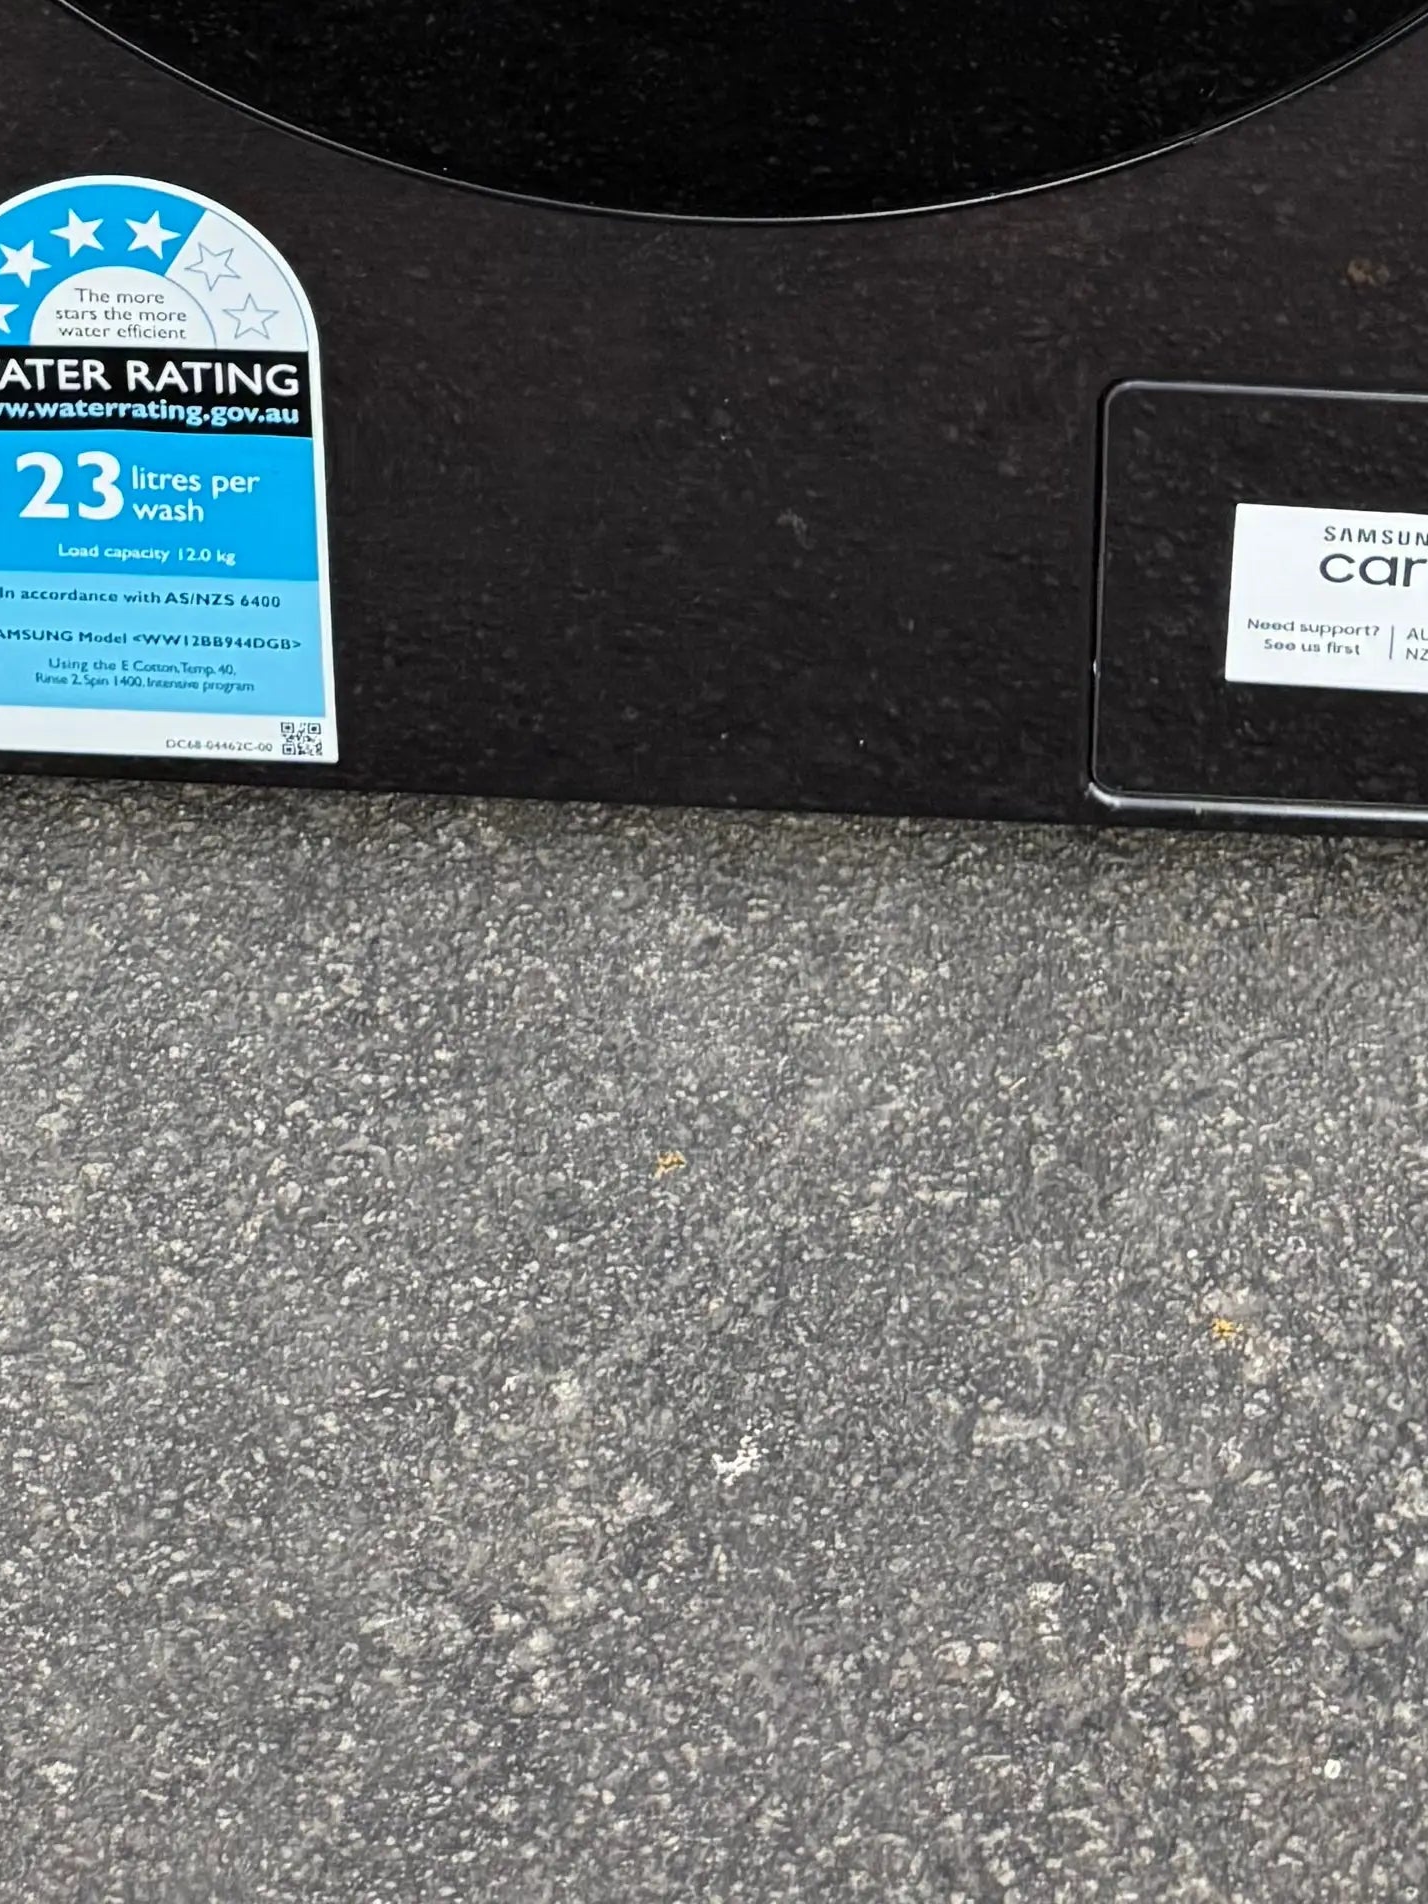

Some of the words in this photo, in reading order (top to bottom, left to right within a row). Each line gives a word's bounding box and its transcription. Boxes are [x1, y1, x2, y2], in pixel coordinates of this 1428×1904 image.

[75, 288, 110, 303] The
[117, 293, 164, 304] more
[56, 308, 97, 321] stars
[104, 308, 132, 321] the
[139, 312, 187, 322] more
[58, 326, 110, 338] water
[117, 324, 187, 339] efficient
[126, 359, 299, 397] RATING
[132, 466, 201, 492] litres
[211, 473, 260, 499] per
[132, 499, 204, 522] wash
[58, 543, 99, 558] Load
[104, 547, 170, 563] capacity
[177, 547, 212, 562] 12.0
[216, 549, 236, 567] kg
[0, 587, 15, 600] In
[21, 588, 118, 603] accordance
[124, 591, 160, 605] with
[164, 592, 235, 607] AS/NZS
[240, 595, 281, 608] 6400
[79, 630, 127, 644] Model
[1247, 618, 1294, 633] Need
[1300, 620, 1380, 638] support?
[1264, 638, 1296, 651] See
[1301, 642, 1321, 654] us
[1326, 641, 1360, 656] first
[48, 658, 88, 673] Using
[93, 659, 116, 670] the
[121, 660, 128, 670] E
